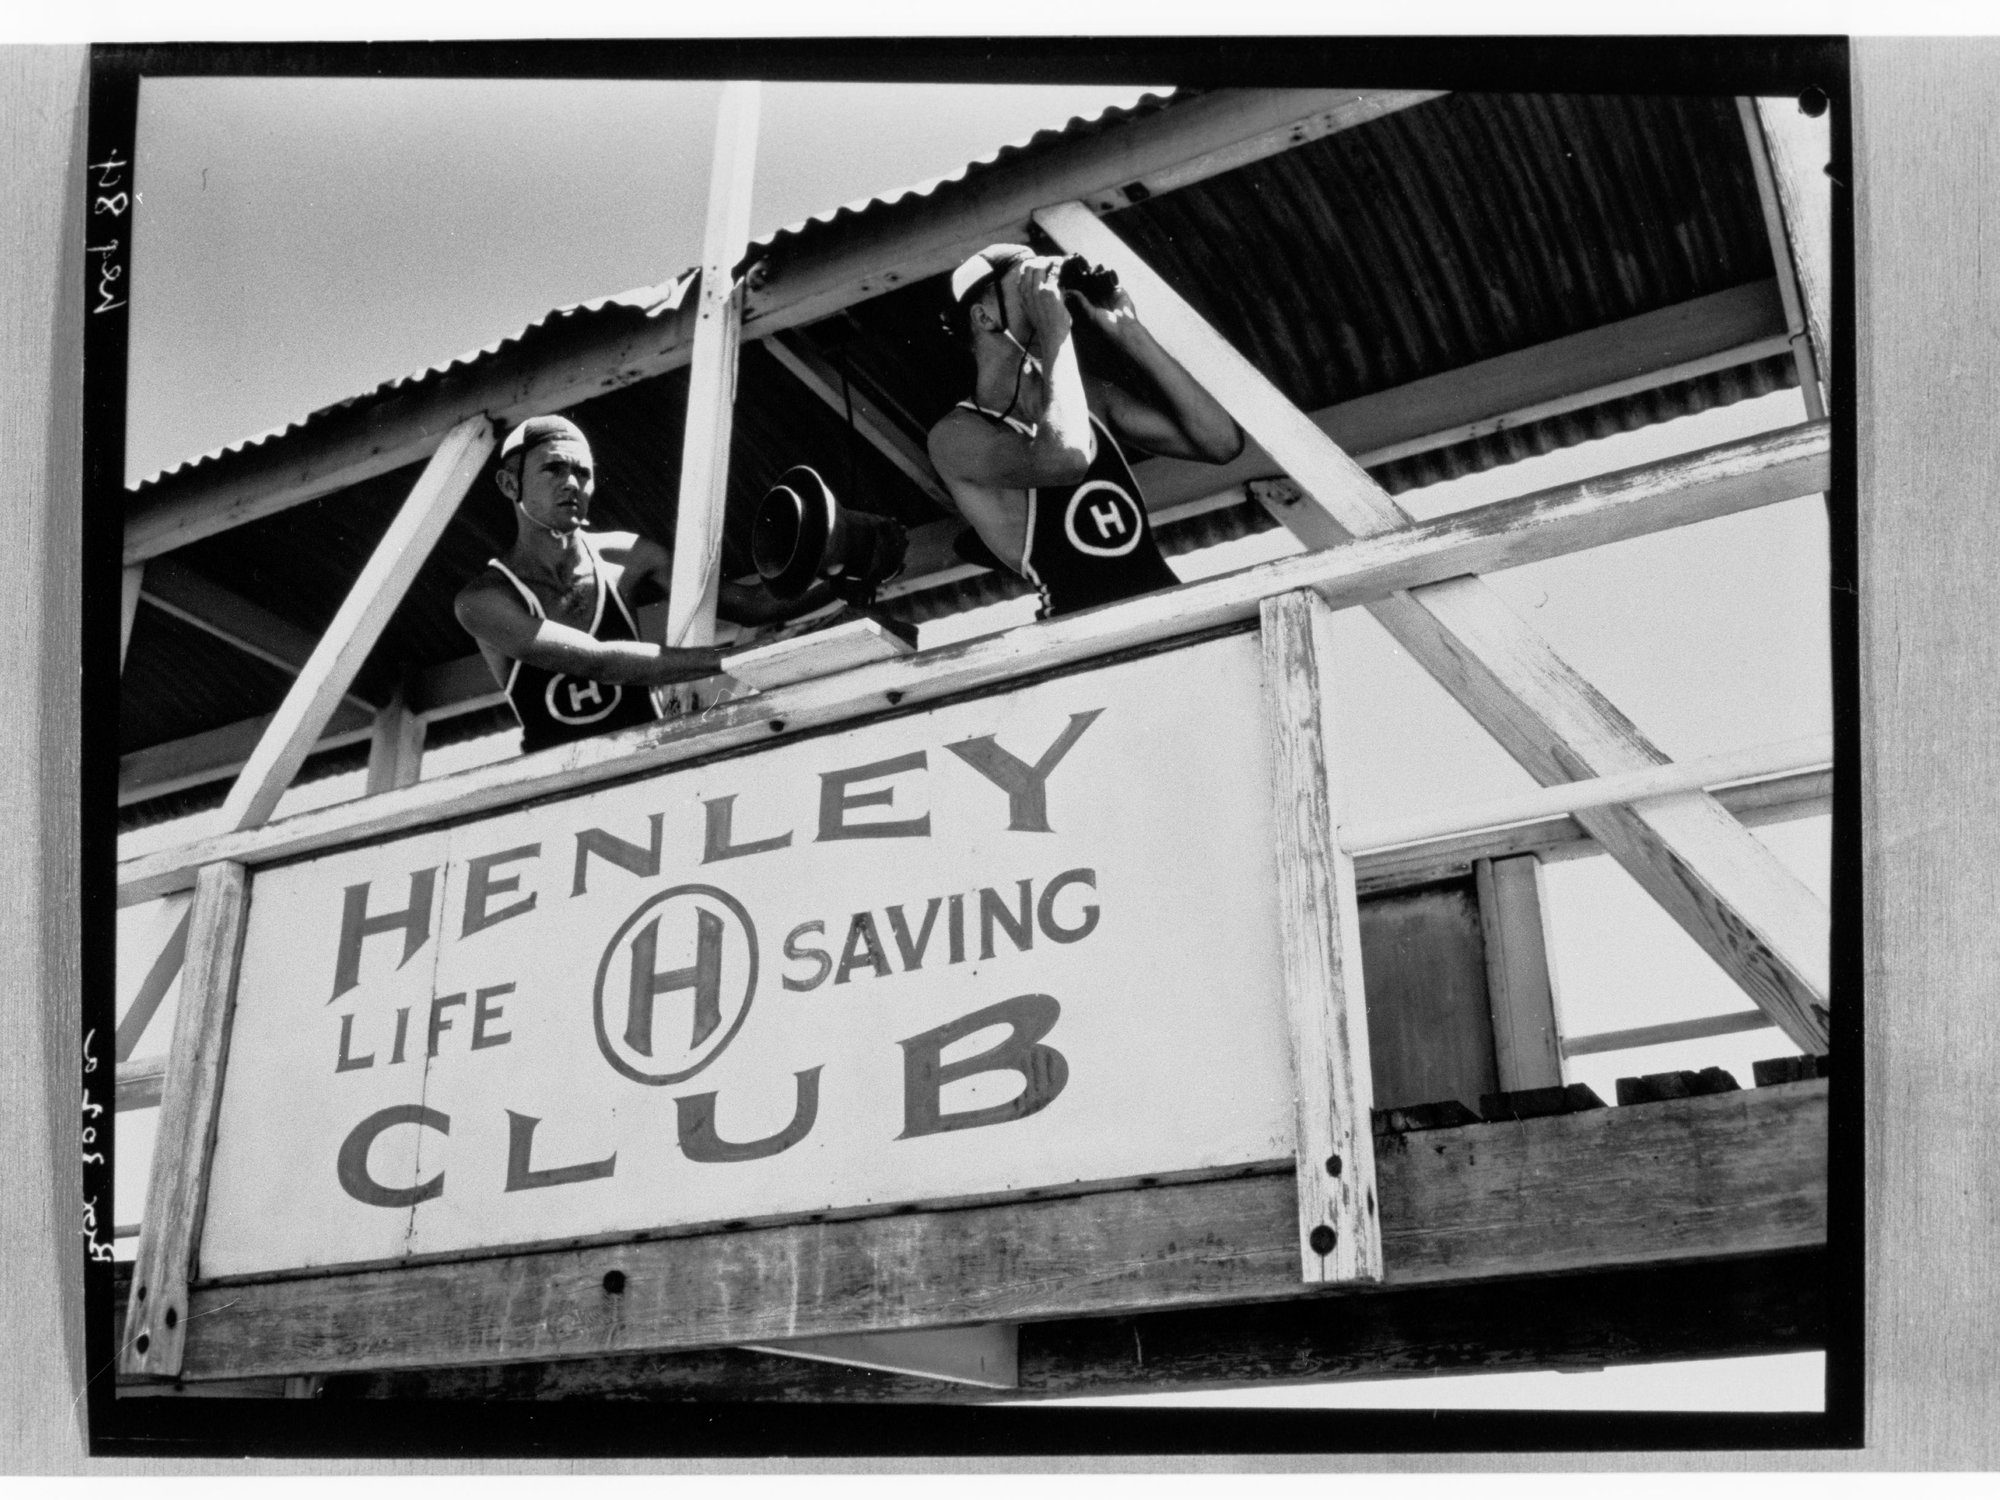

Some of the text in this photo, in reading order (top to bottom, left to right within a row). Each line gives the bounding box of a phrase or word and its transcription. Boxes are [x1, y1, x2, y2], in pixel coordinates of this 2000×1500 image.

[1089, 500, 1126, 539] H
[568, 679, 602, 712] H
[327, 707, 1106, 1005] HENLEY
[334, 867, 1100, 1074] LIFE SAVING
[623, 906, 725, 1058] H
[336, 993, 1070, 1208] CLUB
